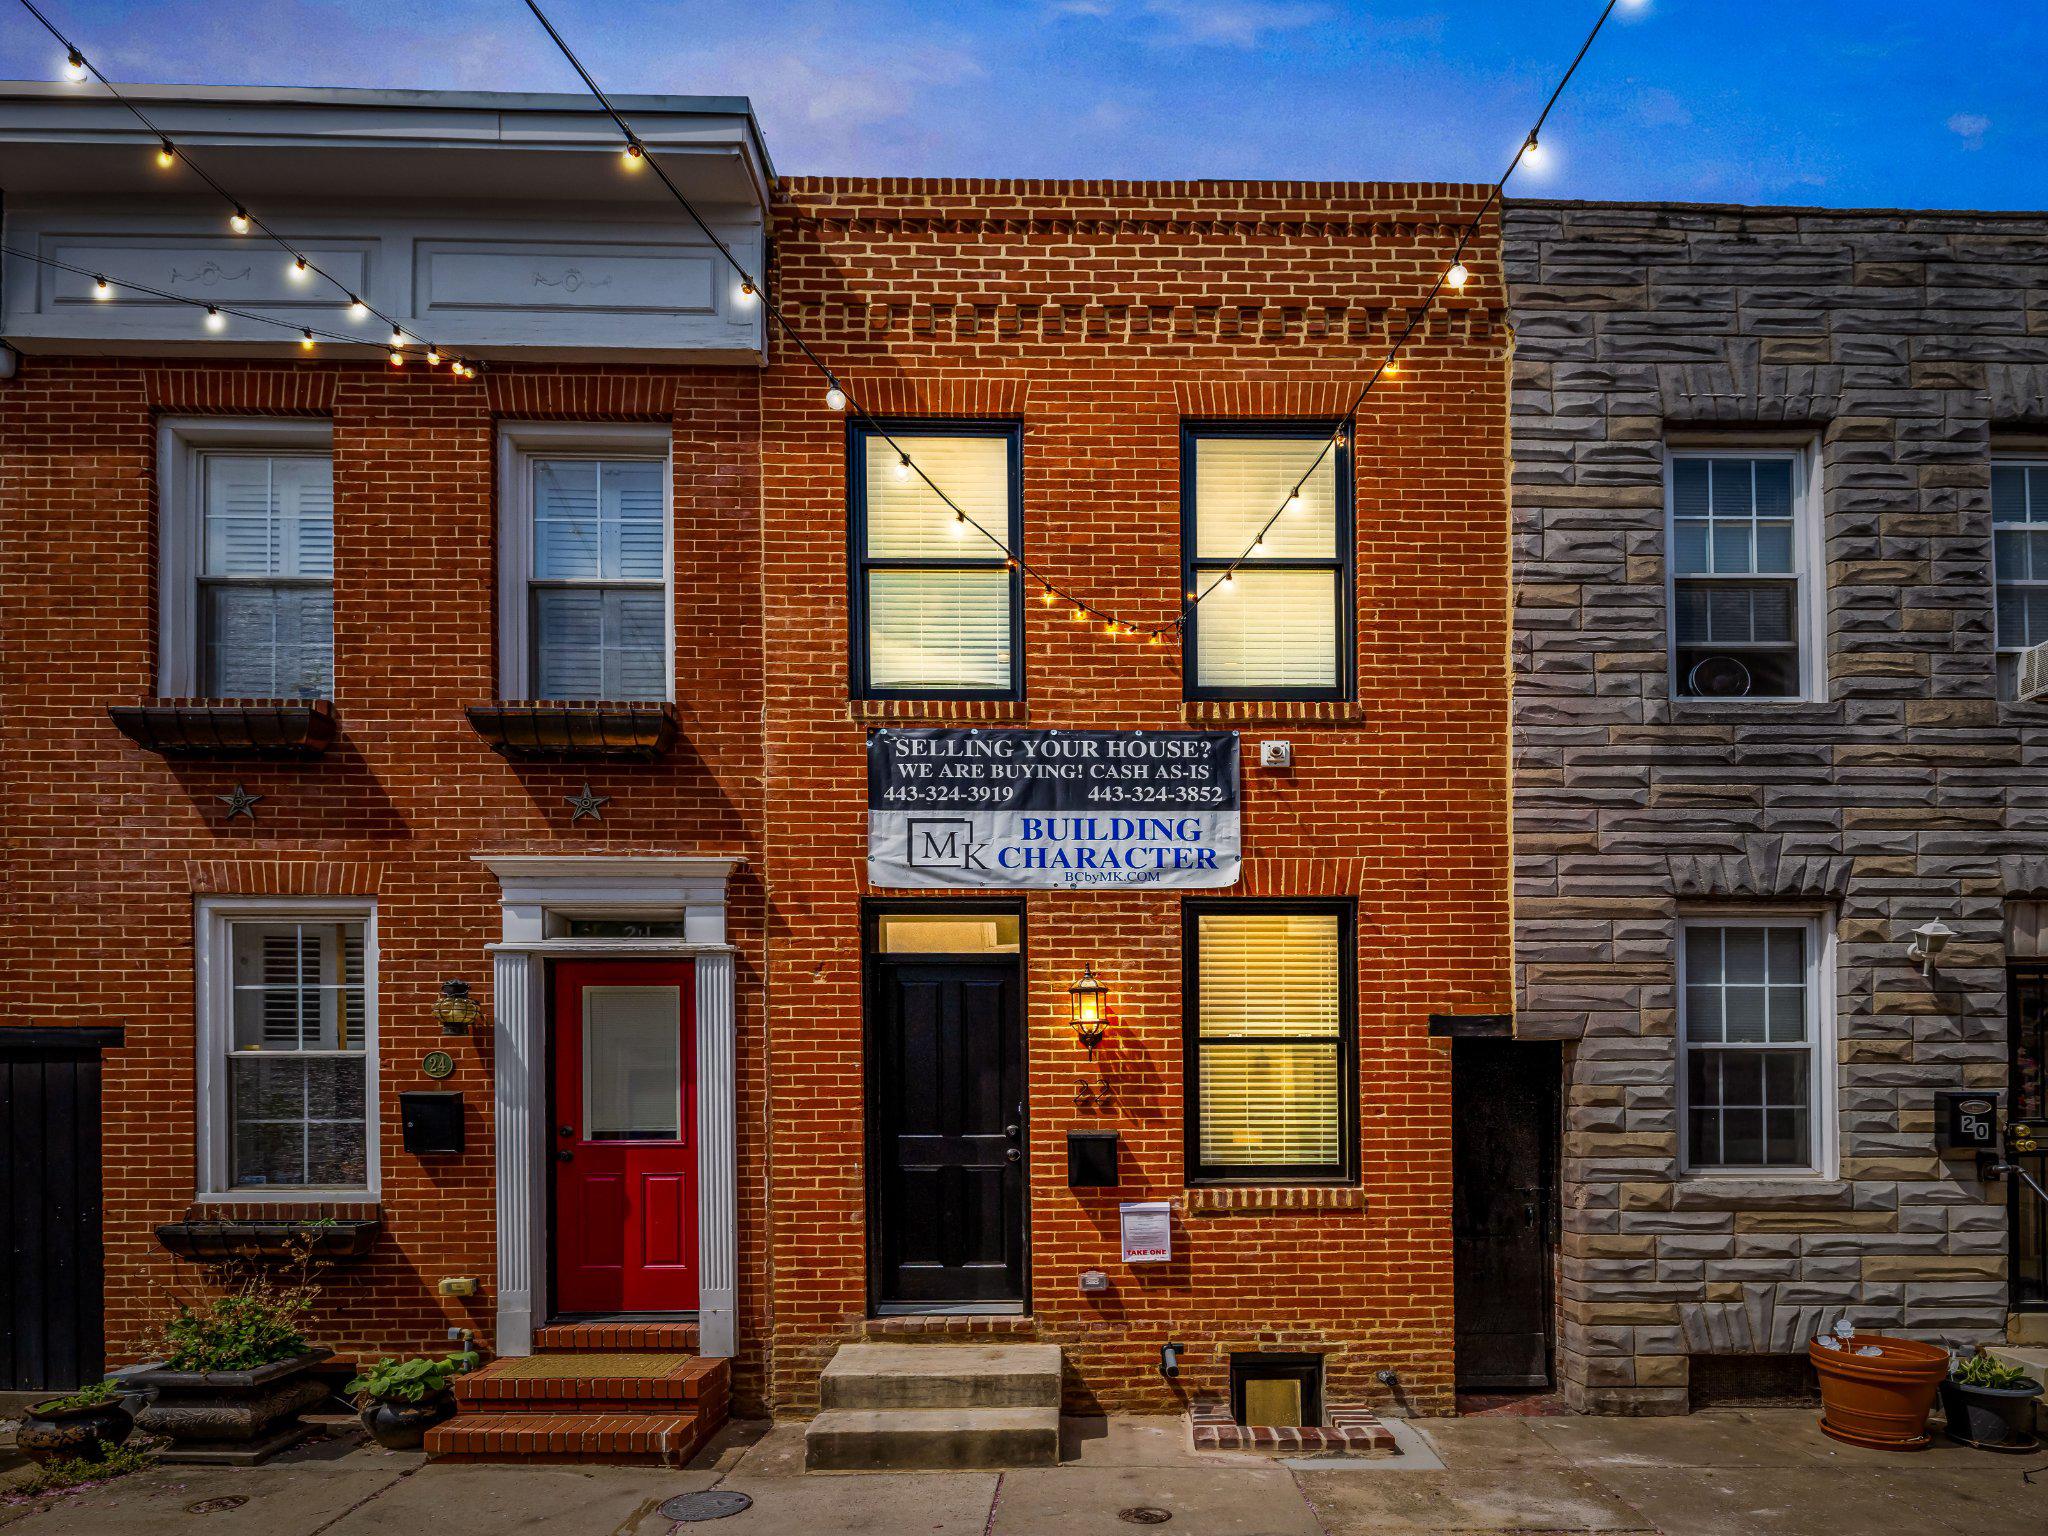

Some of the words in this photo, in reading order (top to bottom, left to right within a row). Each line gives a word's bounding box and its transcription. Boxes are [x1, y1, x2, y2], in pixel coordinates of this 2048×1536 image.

[895, 737, 1014, 758] SELLING
[1023, 739, 1099, 759] YOUR
[1107, 740, 1213, 759] HOUSE?
[898, 764, 933, 779] WE
[938, 764, 985, 779] ARE
[991, 764, 1084, 779] BUYING!
[1089, 764, 1149, 779] CASH
[1155, 764, 1210, 780] AS-IS
[883, 786, 1014, 802] 443-324-3919
[1087, 786, 1223, 803] 443-324-3852
[1020, 818, 1203, 842] BUILDING
[997, 847, 1219, 870] CHARACTER
[1064, 872, 1161, 884] BCbyMK.COM
[429, 1056, 447, 1072] 24
[1072, 1079, 1111, 1106] 22
[1963, 1117, 1988, 1138] 20
